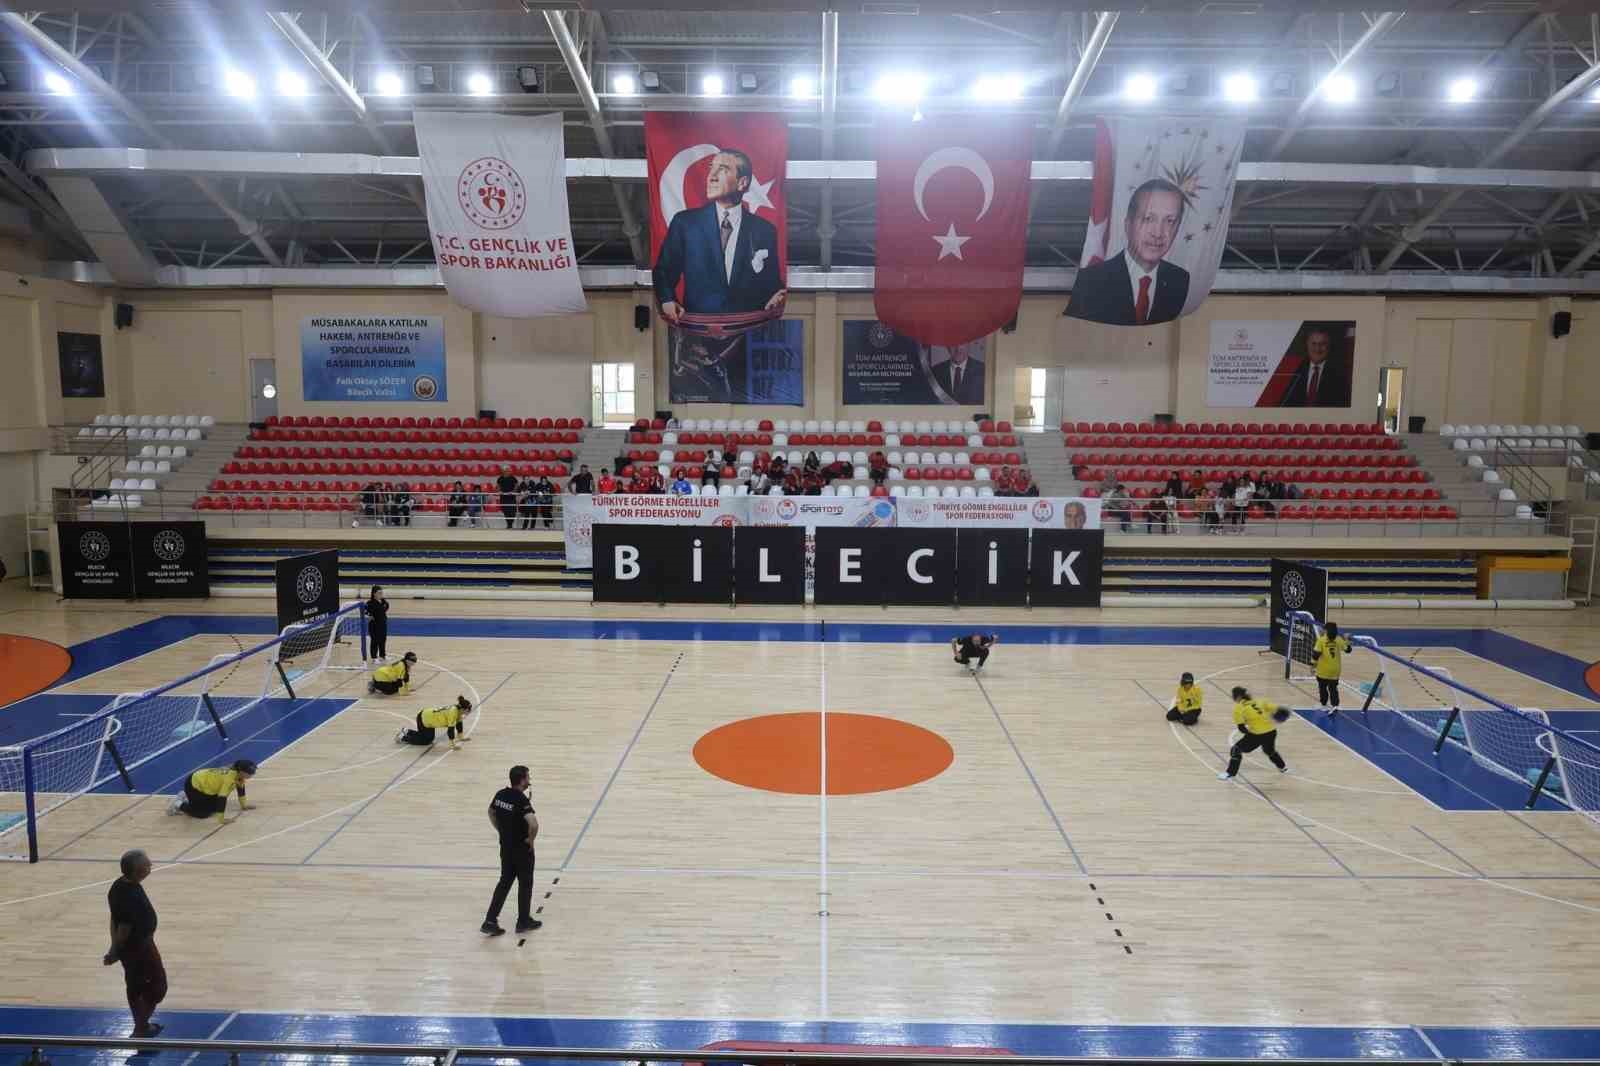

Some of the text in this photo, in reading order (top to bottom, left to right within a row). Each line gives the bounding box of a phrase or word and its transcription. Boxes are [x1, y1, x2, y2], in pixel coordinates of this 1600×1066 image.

[436, 234, 568, 255] T.C. GENÇLİK VE
[440, 253, 571, 271] SPOR BAKANLIĞI
[408, 332, 421, 341] VE
[592, 495, 720, 508] TÜRKİYE GÖRME ENGELLİLER
[608, 508, 701, 519] SPOR FEDERASYONU
